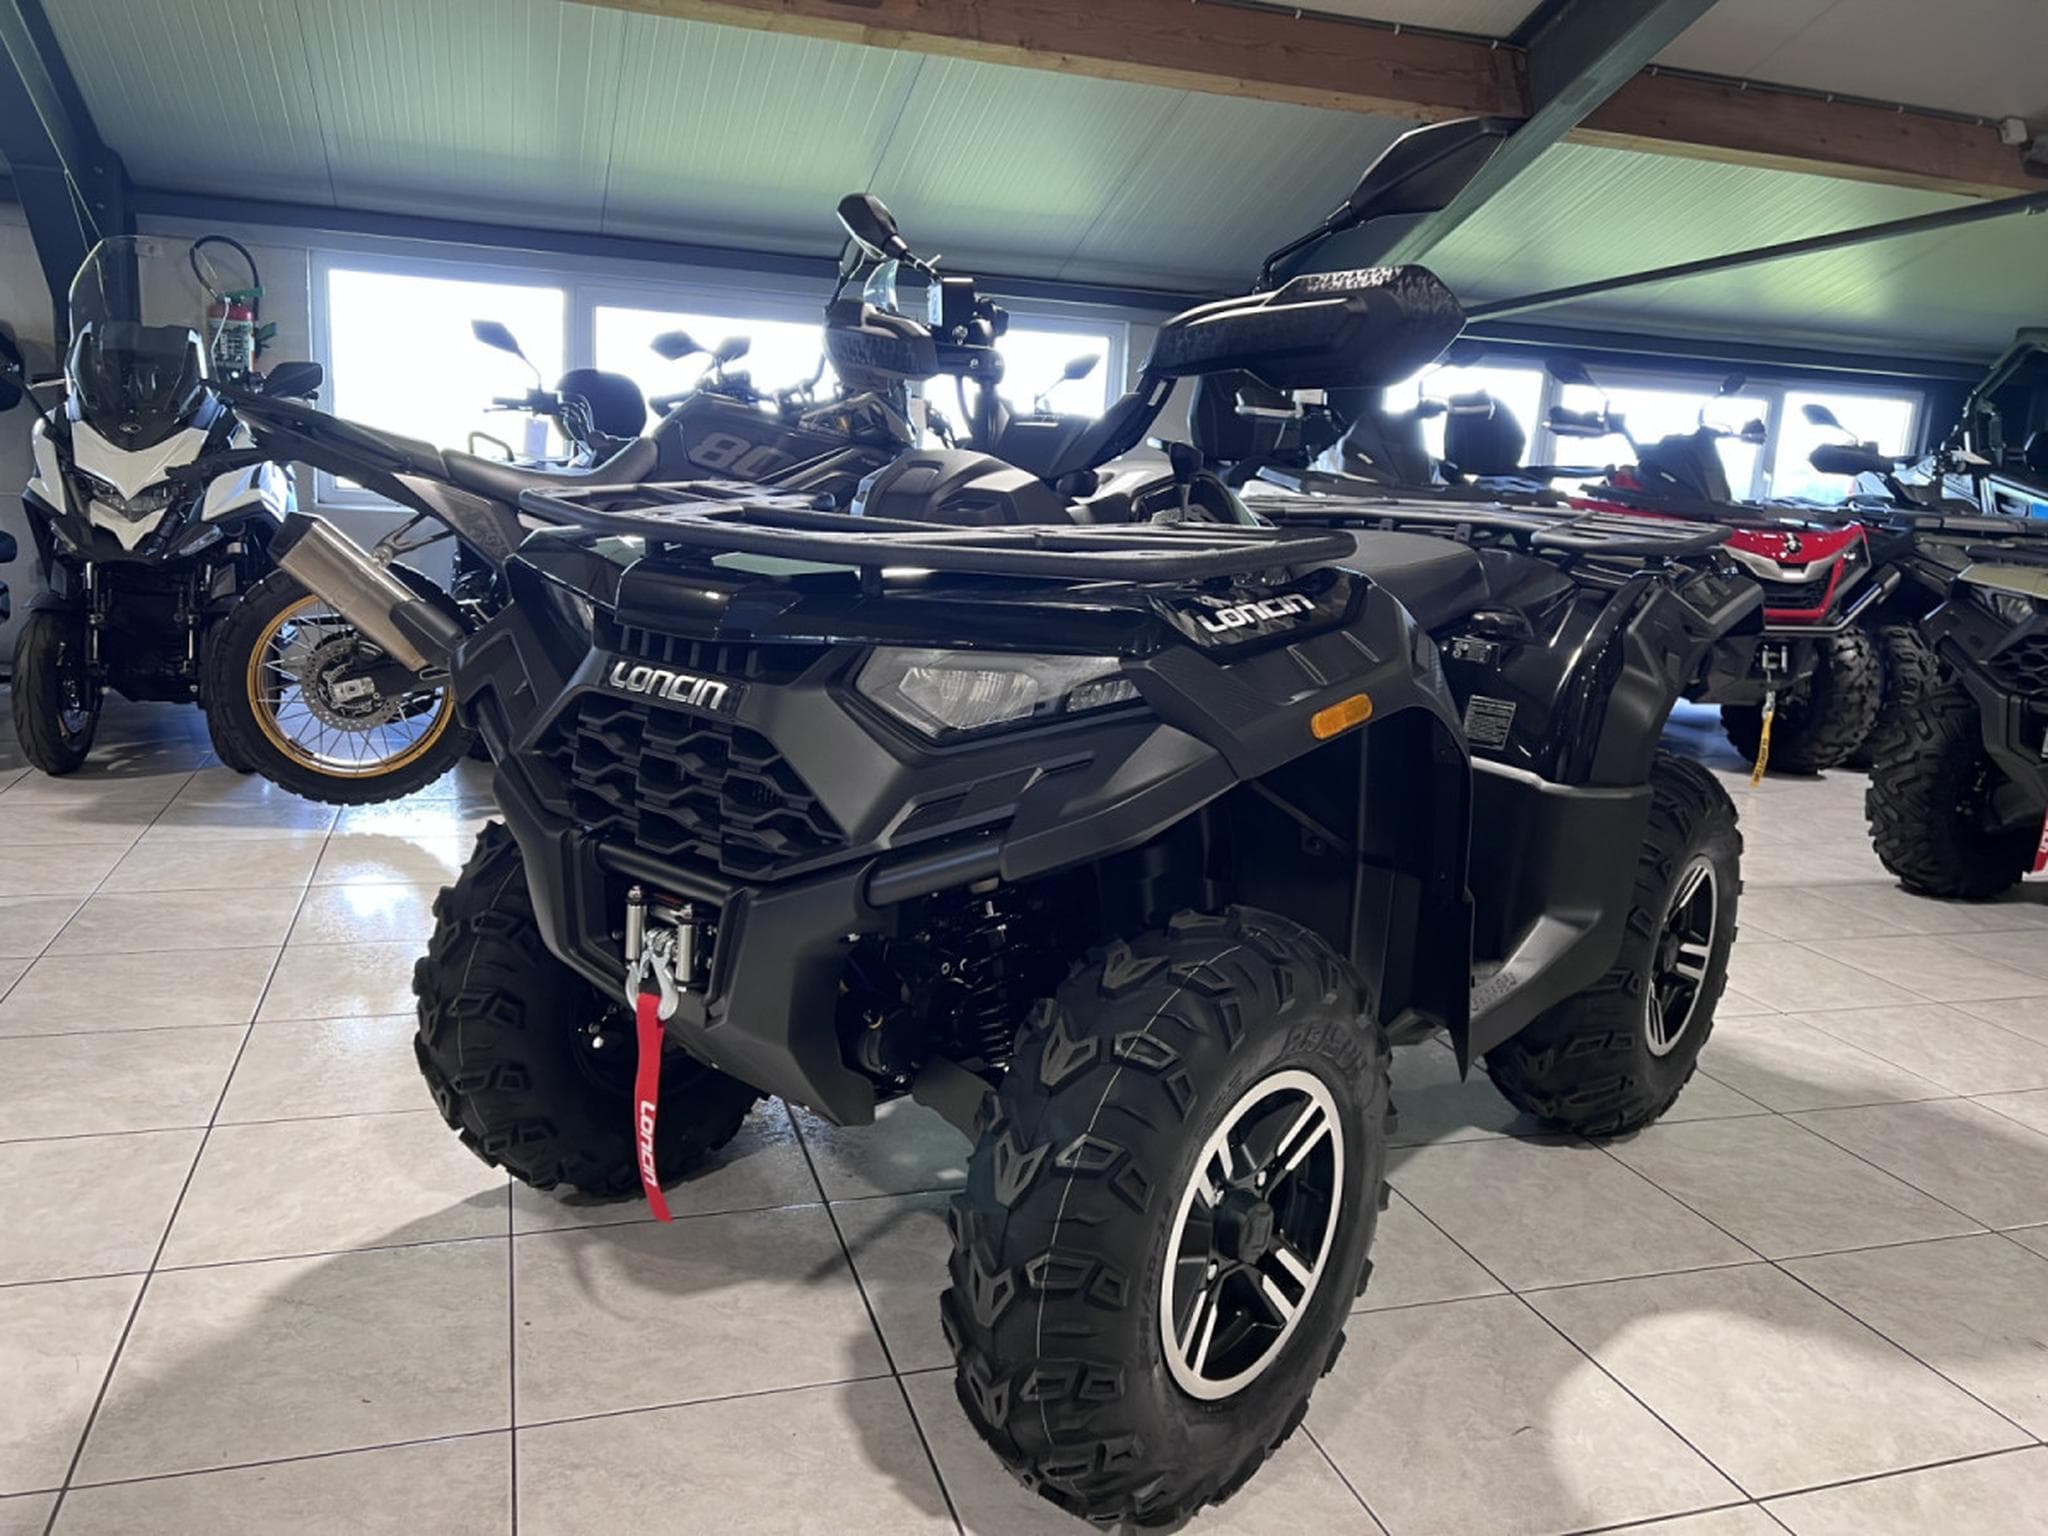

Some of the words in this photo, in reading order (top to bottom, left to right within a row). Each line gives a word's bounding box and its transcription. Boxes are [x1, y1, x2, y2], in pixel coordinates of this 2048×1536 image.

[1196, 593, 1316, 633] LONCIN
[609, 661, 729, 710] LONCIN
[641, 1100, 659, 1187] LONCIN
